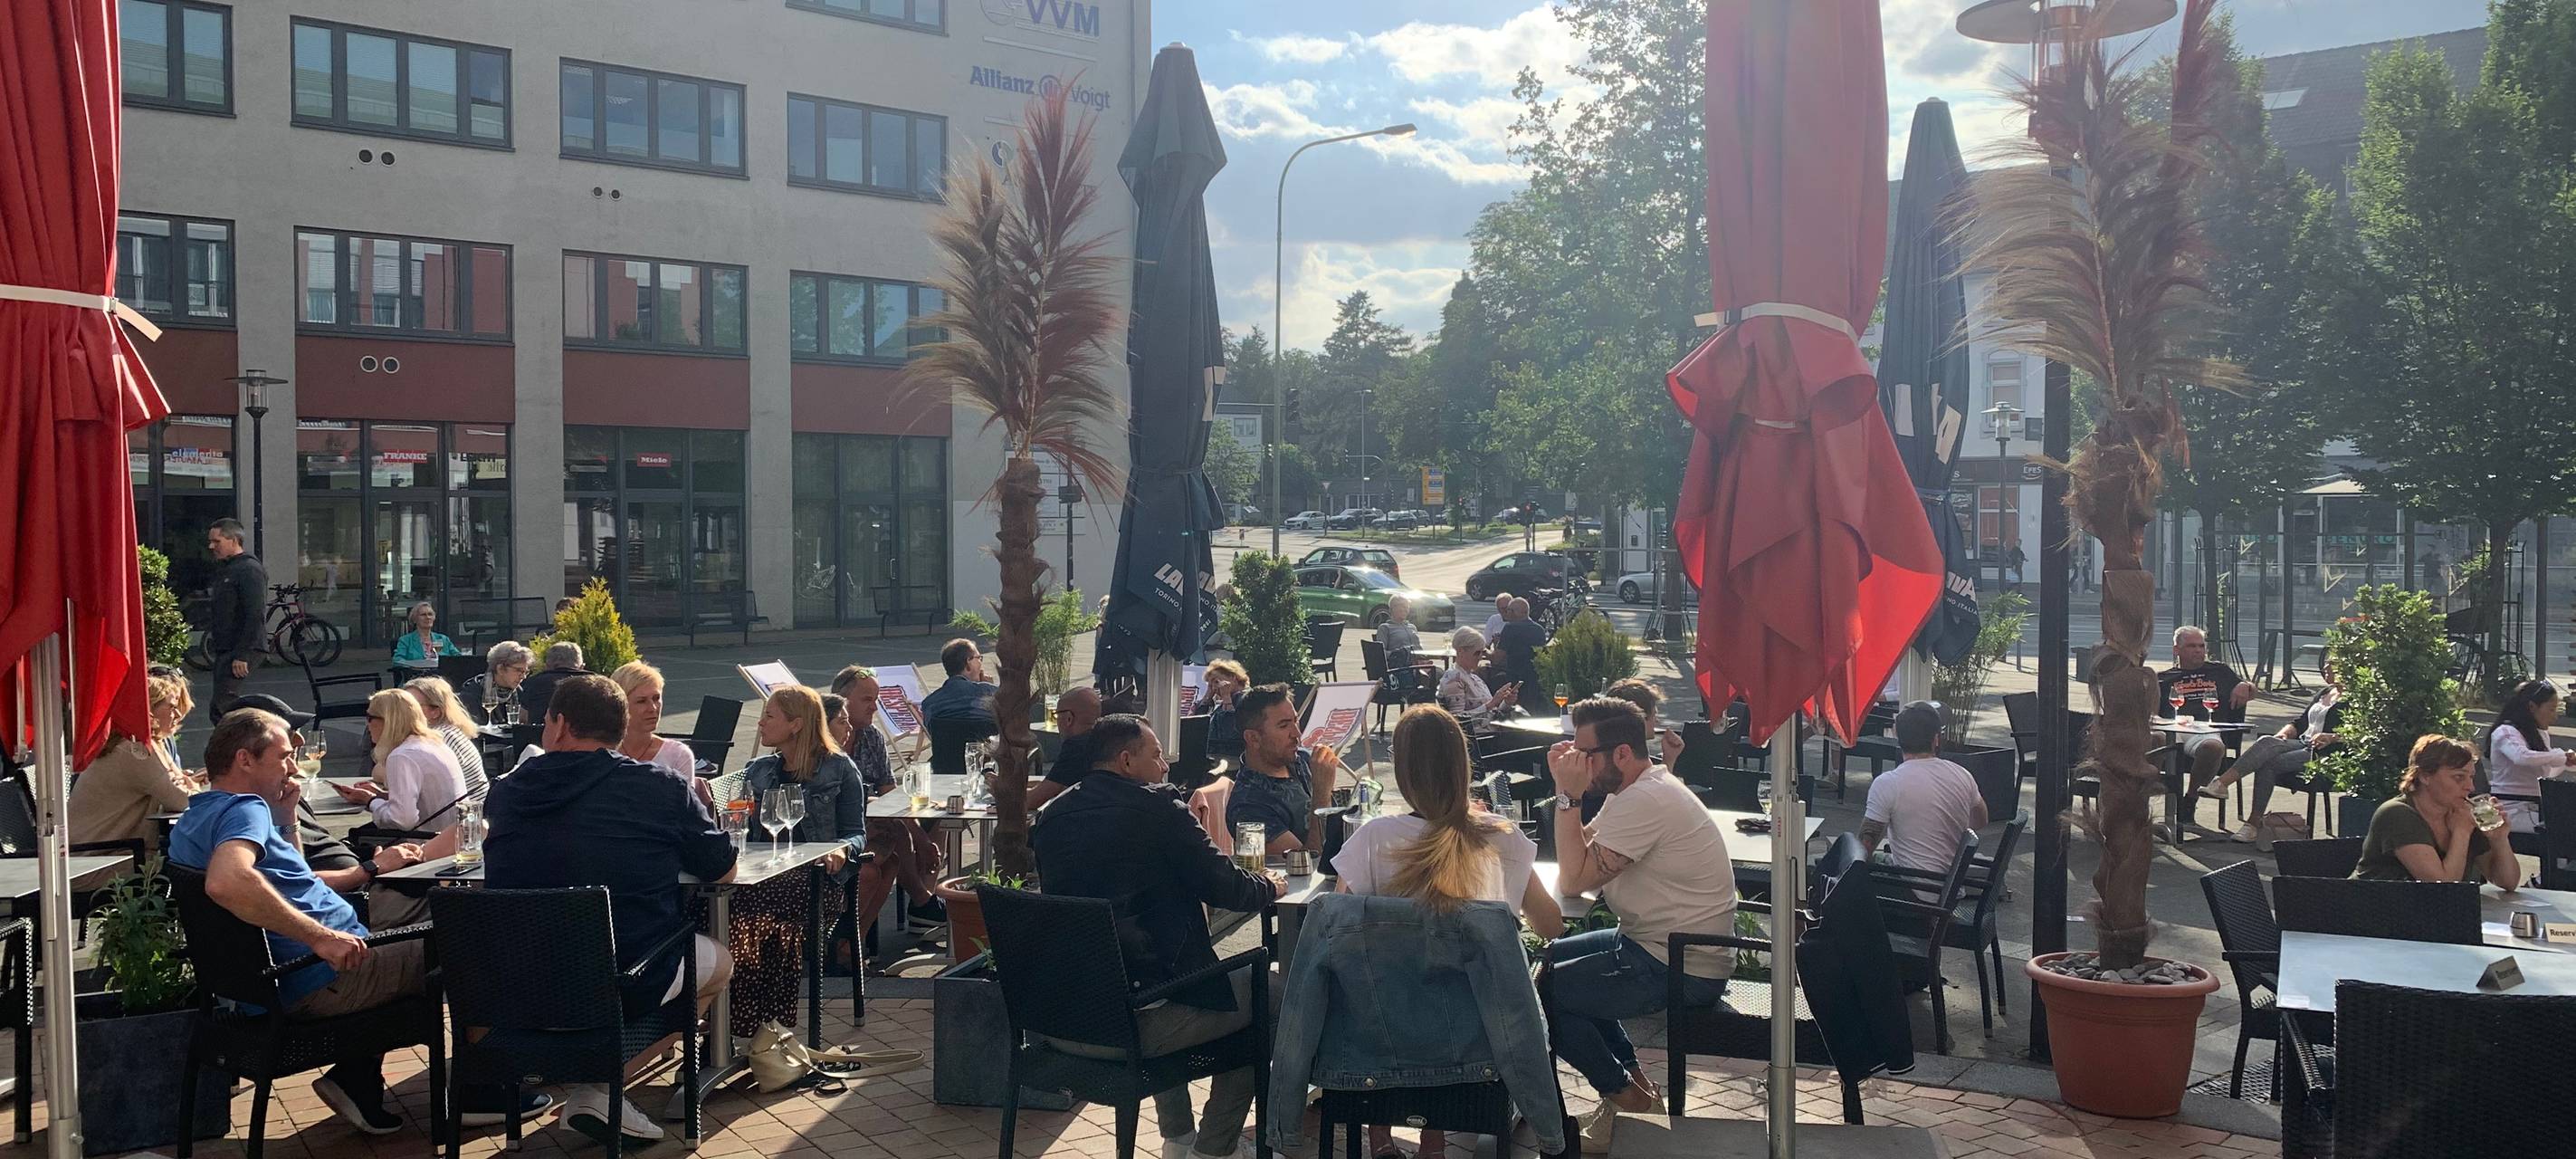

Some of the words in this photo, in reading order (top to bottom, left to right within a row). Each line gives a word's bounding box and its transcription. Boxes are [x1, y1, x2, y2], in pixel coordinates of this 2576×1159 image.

[969, 65, 1035, 95] Allianz
[1071, 85, 1111, 111] Voigt
[384, 452, 427, 460] FRANKE
